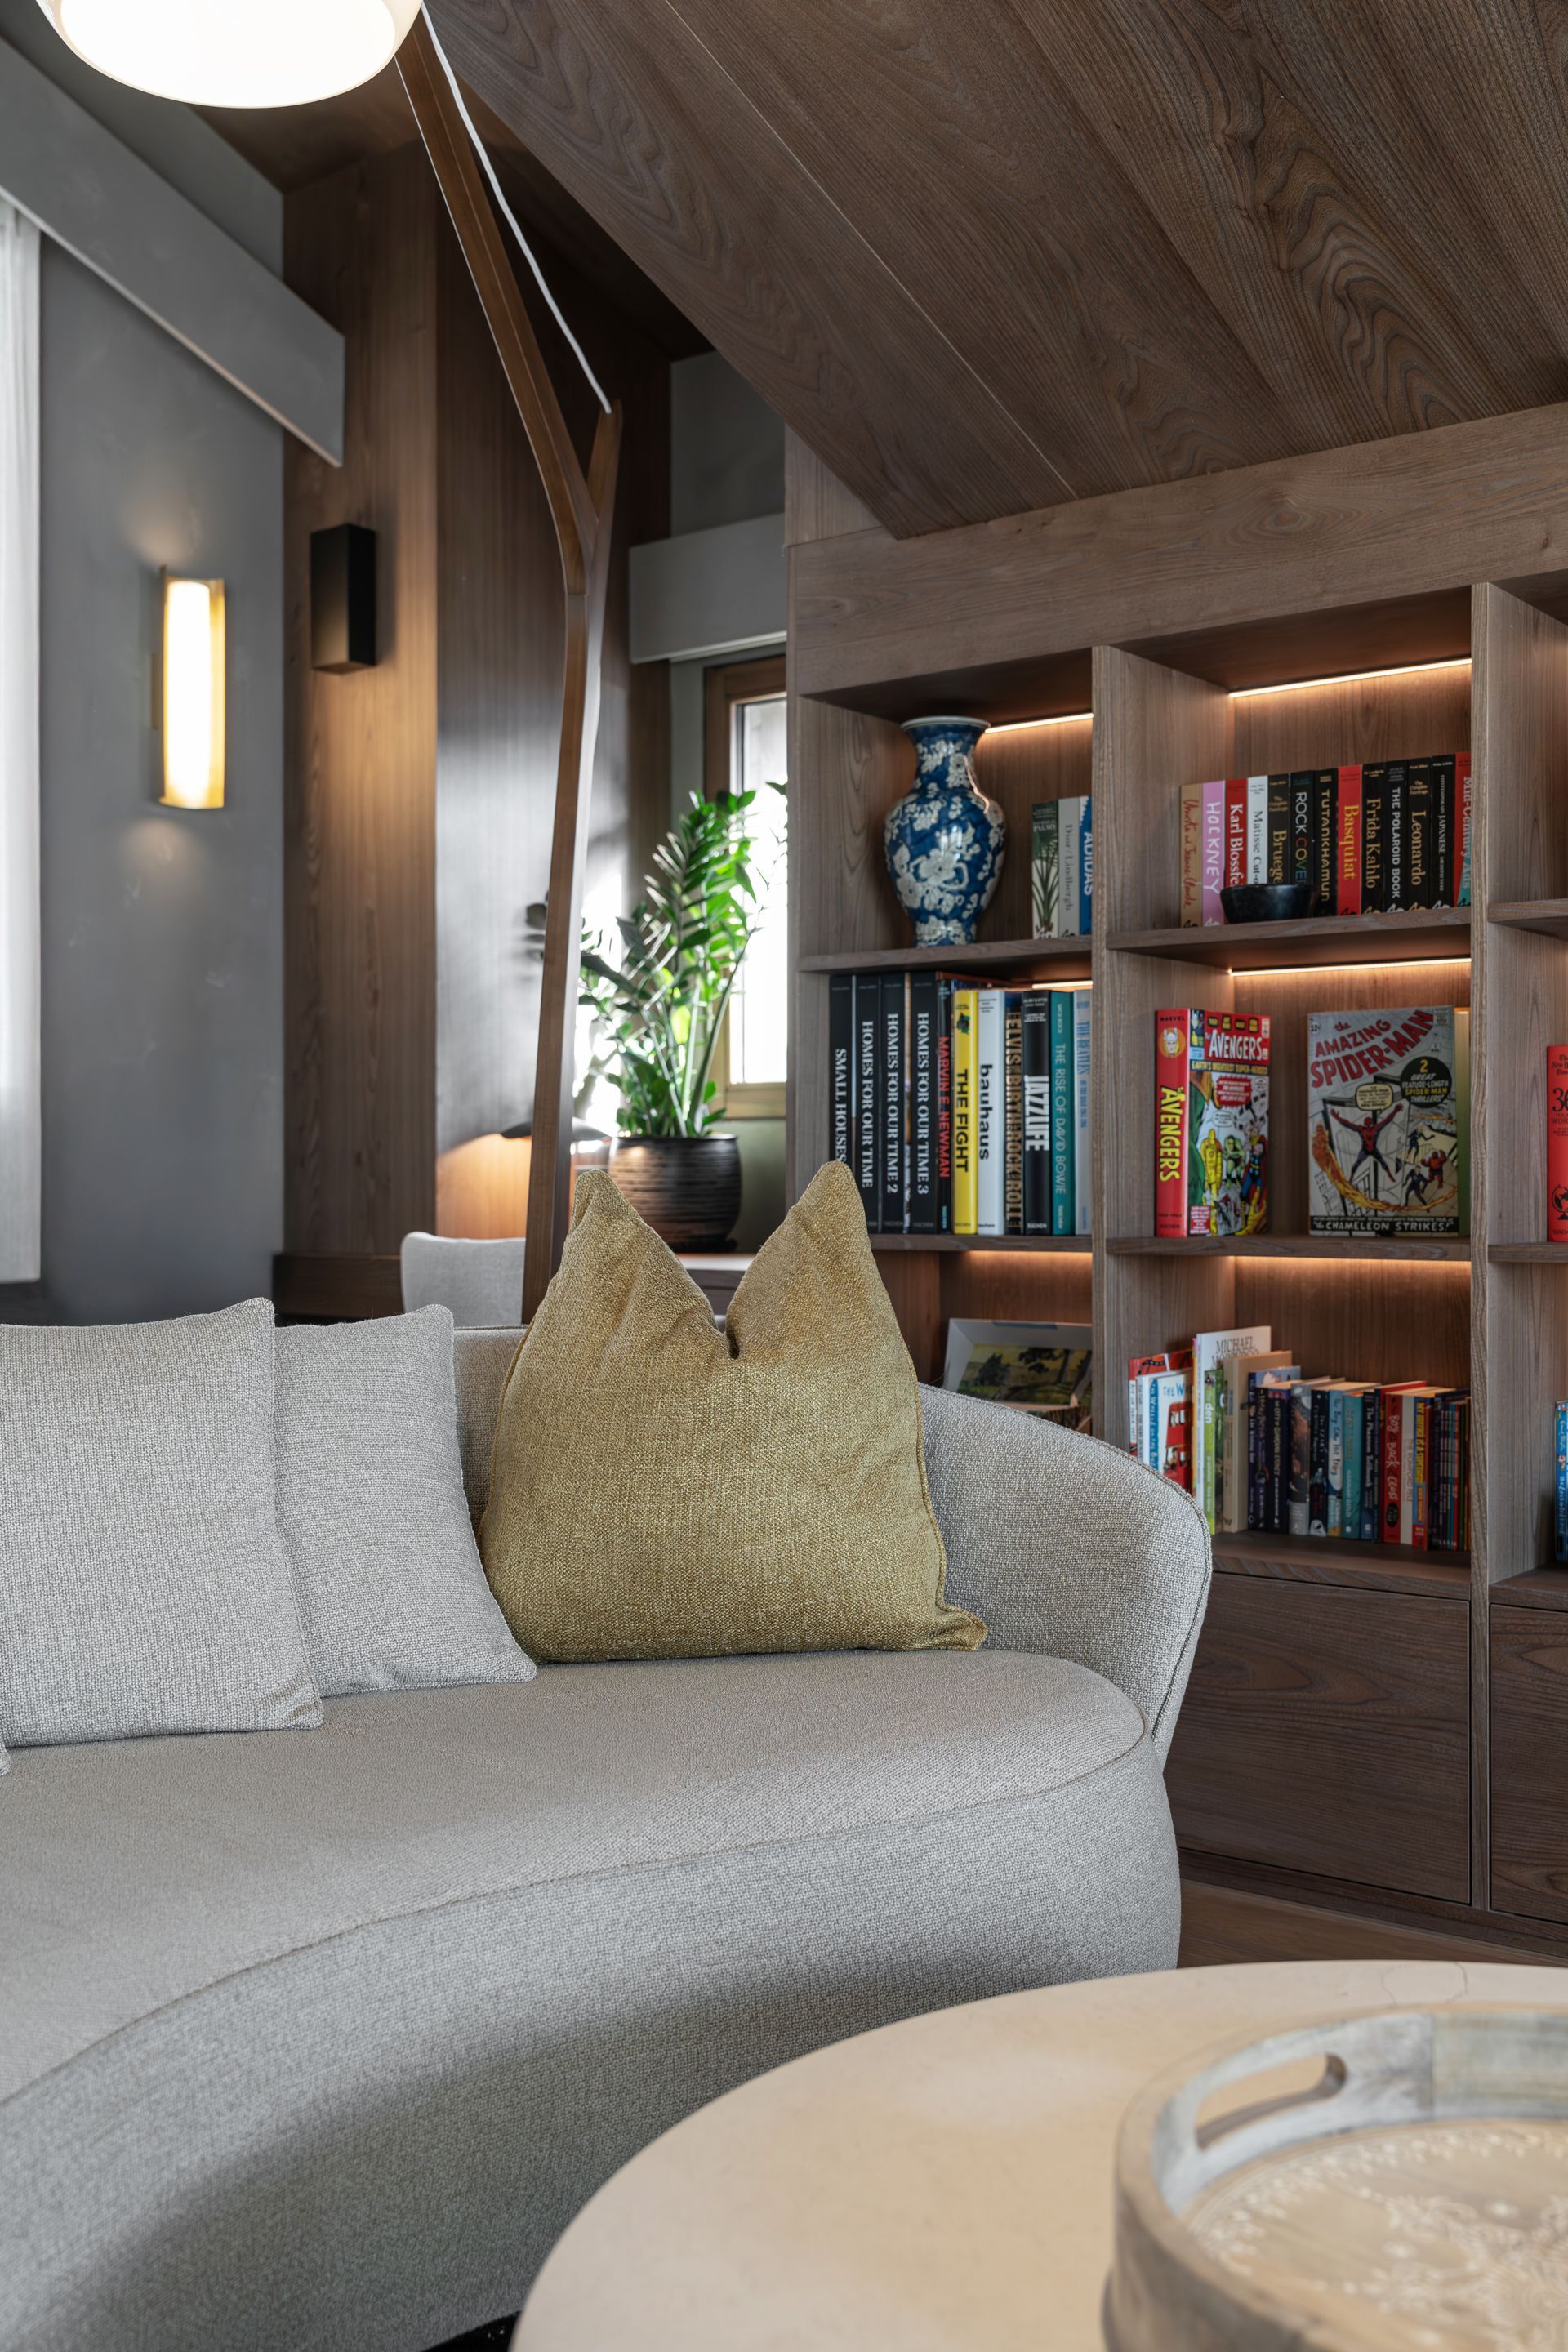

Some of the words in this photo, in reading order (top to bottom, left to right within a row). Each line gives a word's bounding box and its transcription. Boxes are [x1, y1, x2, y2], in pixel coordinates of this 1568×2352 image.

[1295, 791, 1307, 834] ROCK
[1392, 786, 1401, 808] THE
[1230, 803, 1244, 834] Karl
[1253, 810, 1264, 853] Matisse
[1365, 797, 1382, 842] Frida
[1437, 814, 1446, 855] JAPANESE
[1460, 777, 1472, 859] Mid-Century
[1203, 801, 1221, 894] HOCKNEY
[1339, 804, 1360, 880] Basquiat
[1392, 811, 1401, 866] POLAROID
[1410, 809, 1427, 885] Leonardo
[1084, 831, 1093, 896] ADIDAS
[1230, 836, 1244, 887] Blossfe
[1295, 836, 1307, 885] COVE
[1365, 842, 1382, 889] Kahlo
[1463, 862, 1472, 889] Ads
[1392, 868, 1401, 898] BOOK
[861, 1021, 874, 1076] HOMES
[887, 1013, 899, 1068] HOMES
[916, 1012, 929, 1068] HOMES
[1005, 1018, 1022, 1066] ELVIS
[1054, 1043, 1067, 1066] THE
[1208, 1029, 1263, 1061] AVENGERS
[1314, 1018, 1392, 1058] AMAZING
[835, 1048, 847, 1100] SMALL
[938, 1036, 950, 1093] MARVIN
[1054, 1068, 1067, 1094] RISE
[1419, 1058, 1428, 1073] 2
[861, 1078, 874, 1109] FOR
[887, 1071, 899, 1102] FOR
[916, 1071, 929, 1102] FOR
[938, 1095, 949, 1107] E.
[956, 1068, 969, 1108] THE
[1005, 1074, 1022, 1125] BIRTH
[1054, 1096, 1067, 1115] OF
[835, 1102, 847, 1161] HOUSES
[861, 1111, 874, 1145] OUR
[887, 1105, 899, 1139] OUR
[916, 1105, 929, 1139] OUR
[979, 1063, 993, 1160] bauhaus
[1024, 1075, 1050, 1152] JAZZLIFE
[938, 1111, 950, 1178] NEWMAN
[956, 1111, 969, 1173] FIGHT
[1005, 1132, 1022, 1174] ROCK
[1054, 1117, 1067, 1152] DAVID
[1159, 1085, 1186, 1182] AVENGERS
[861, 1147, 874, 1187] TIME
[887, 1141, 899, 1182] TIME
[916, 1141, 929, 1182] TIME
[1054, 1156, 1067, 1194] BOWIE
[887, 1183, 899, 1193] 2
[916, 1183, 929, 1195] 3
[1005, 1183, 1022, 1221] ROLL
[1325, 1221, 1390, 1231] CHAMELEON
[1215, 1336, 1255, 1354] MICHAEL
[1205, 1402, 1214, 1424] den
[1365, 1406, 1374, 1421] The
[1365, 1422, 1374, 1454] Phantom
